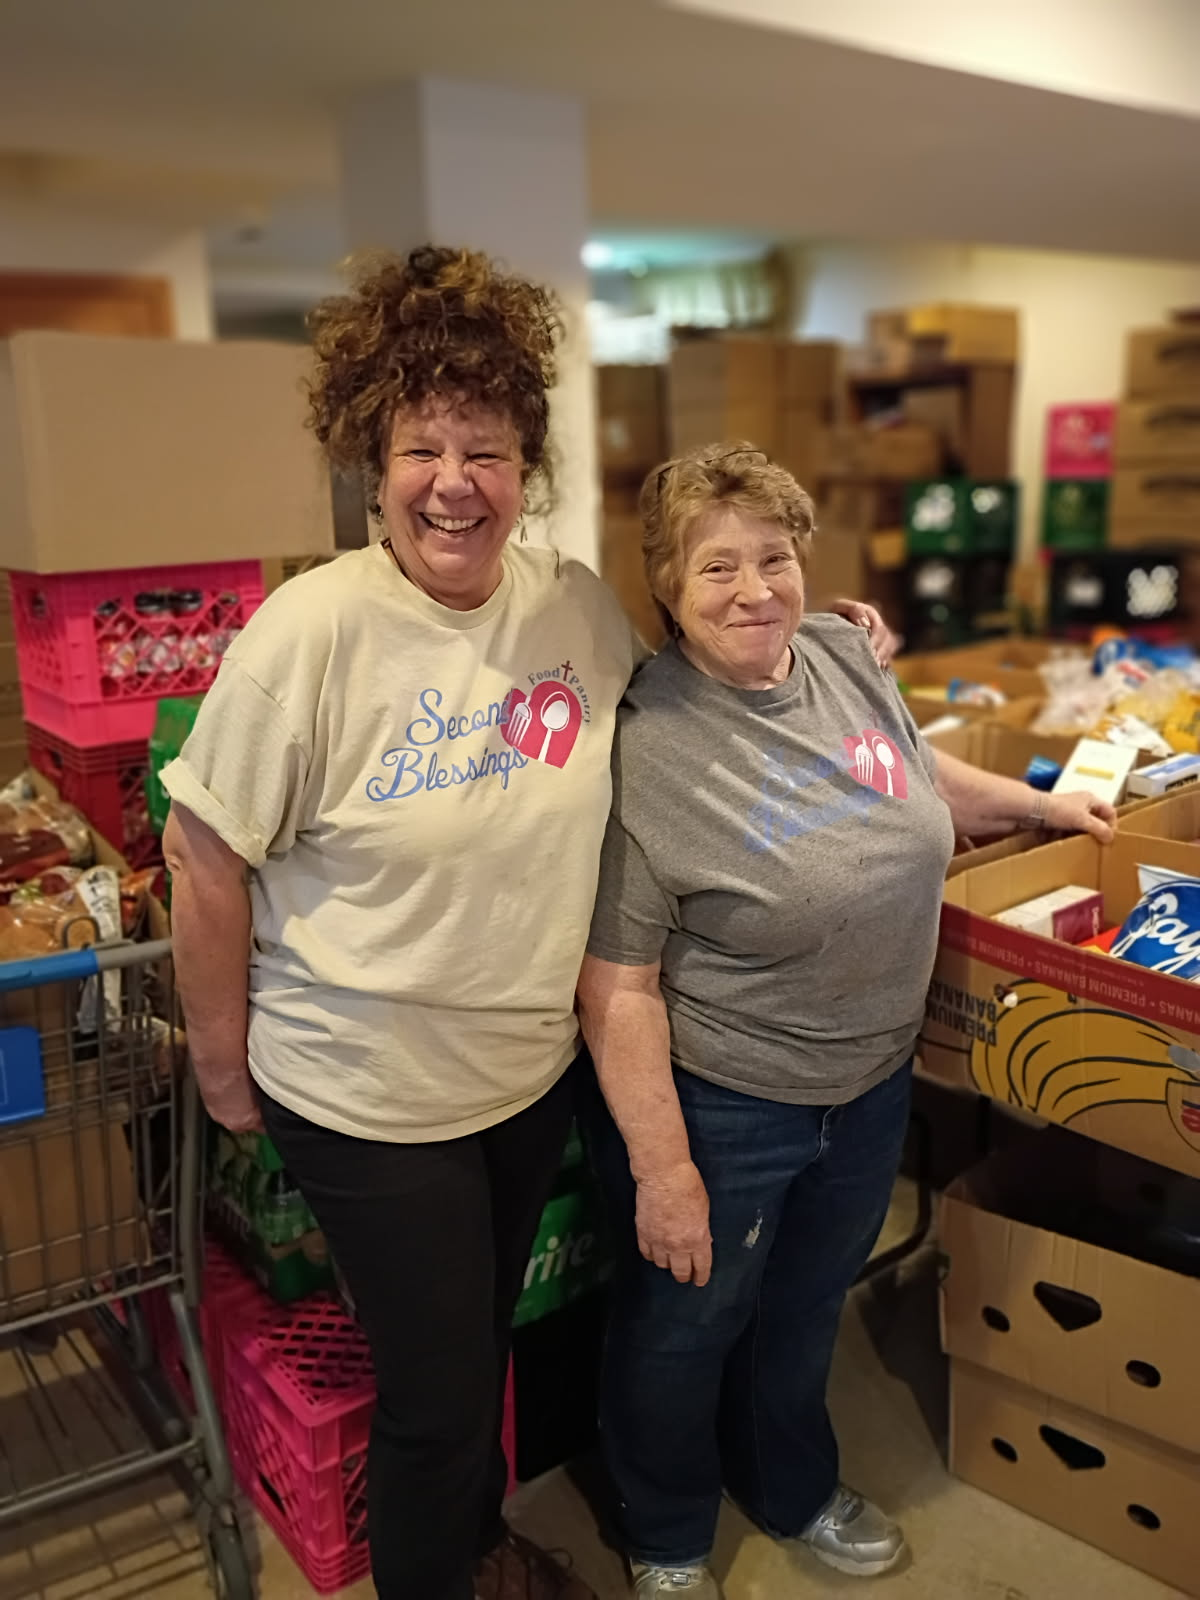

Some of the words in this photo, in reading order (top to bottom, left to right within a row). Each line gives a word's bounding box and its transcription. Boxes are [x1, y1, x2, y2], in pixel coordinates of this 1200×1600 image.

[406, 688, 513, 746] Second
[528, 667, 560, 686] Food
[568, 674, 591, 724] Pantry
[366, 747, 529, 802] Blessings
[1034, 960, 1086, 991] BANANAS
[1088, 977, 1147, 1008] PREMIUM
[926, 1000, 997, 1047] PREMIUM
